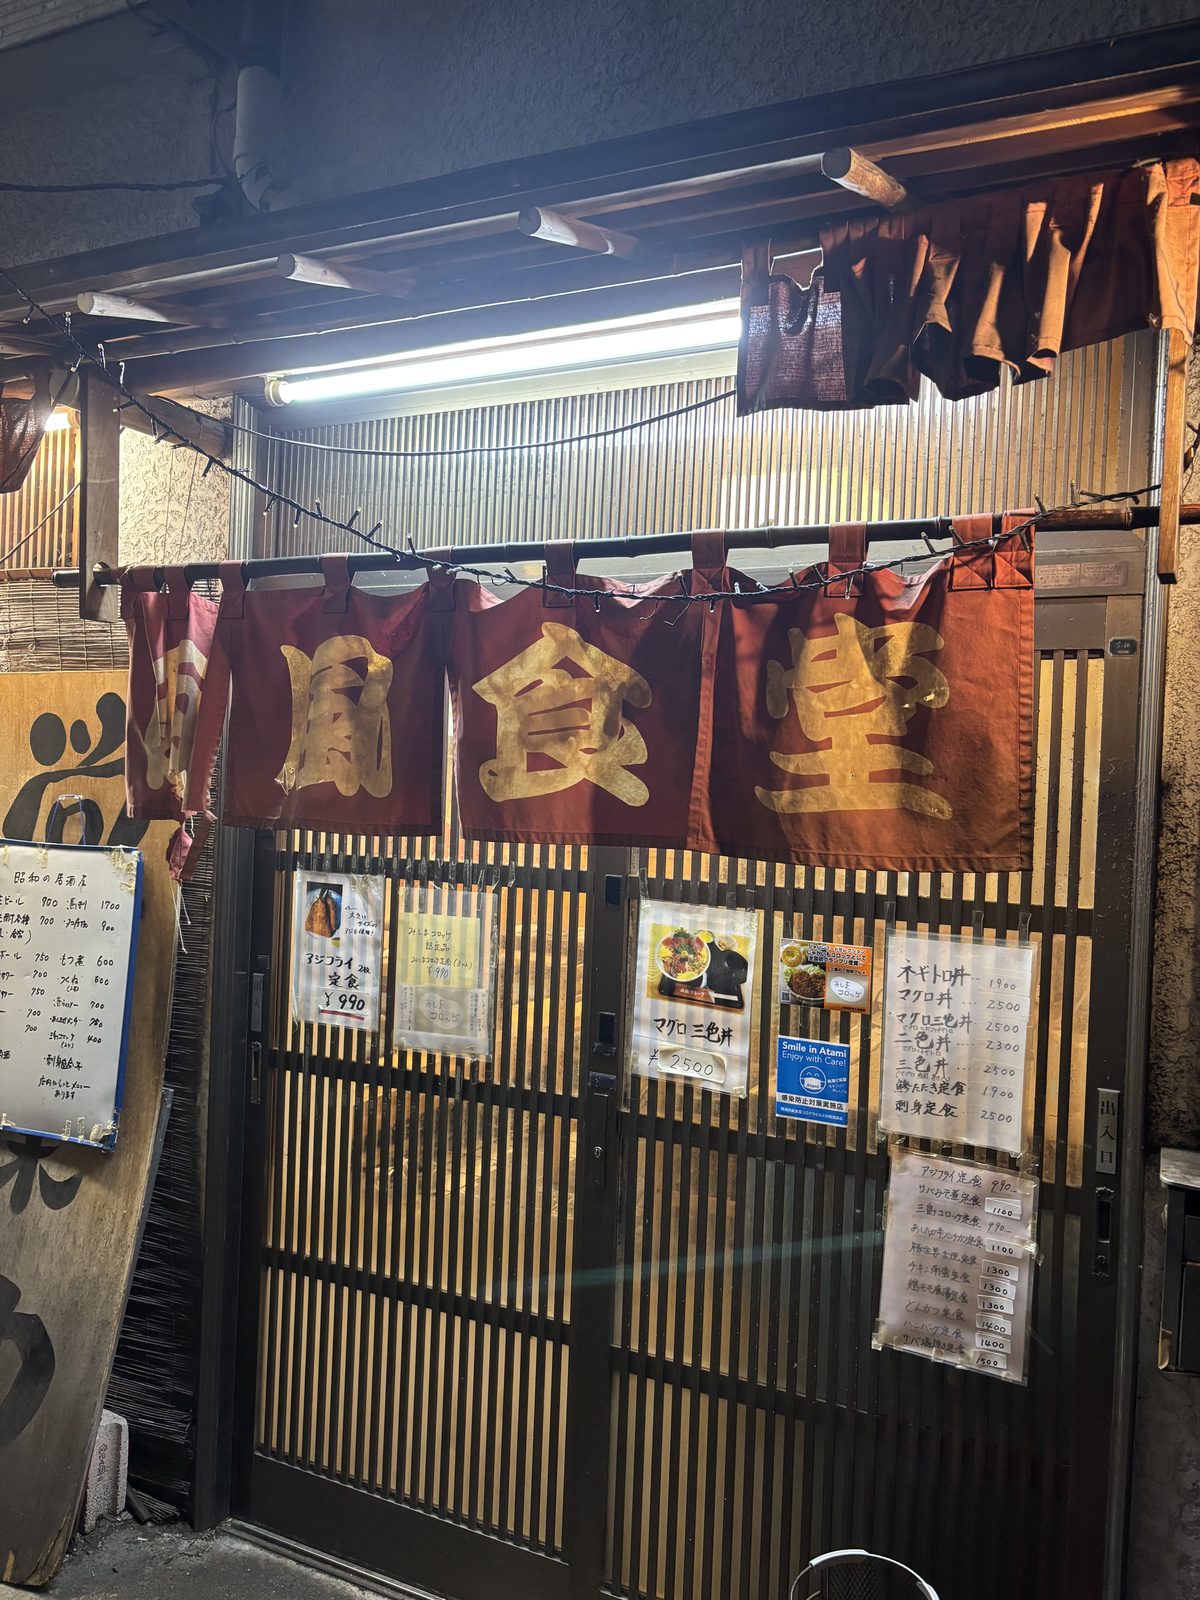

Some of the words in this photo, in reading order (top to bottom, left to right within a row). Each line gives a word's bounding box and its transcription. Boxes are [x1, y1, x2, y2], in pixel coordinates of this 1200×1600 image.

[14, 871, 87, 892] 昭和の居酒屋
[100, 900, 121, 910] 1700
[40, 915, 55, 926] 700
[34, 952, 50, 962] 750
[96, 955, 114, 967] 600
[33, 969, 48, 979] 700
[328, 973, 360, 990] 定食
[988, 977, 1017, 992] 1900
[31, 987, 46, 997] 750
[90, 1000, 105, 1009] 700
[986, 999, 1021, 1013] 2500
[26, 1008, 41, 1018] 700
[25, 1024, 38, 1033] 700
[985, 1021, 1020, 1034] 2500
[782, 1041, 807, 1053] Smile
[808, 1045, 818, 1054] in
[818, 1046, 847, 1059] Atami
[985, 1042, 1020, 1053] 2300
[670, 1054, 714, 1077] 2500
[782, 1050, 804, 1063] Enjoy
[805, 1055, 823, 1063] with
[824, 1056, 847, 1068] Care!
[983, 1065, 1016, 1077] 2500
[981, 1085, 1014, 1100] 1900
[980, 1109, 1013, 1123] 2500
[1099, 1100, 1116, 1164] 出入口
[991, 1244, 1014, 1255] 1100
[986, 1265, 1011, 1277] 1300
[983, 1283, 1008, 1296] 1300
[982, 1301, 1005, 1311] 1300
[981, 1321, 1006, 1334] 1400
[980, 1338, 1005, 1350] 1400
